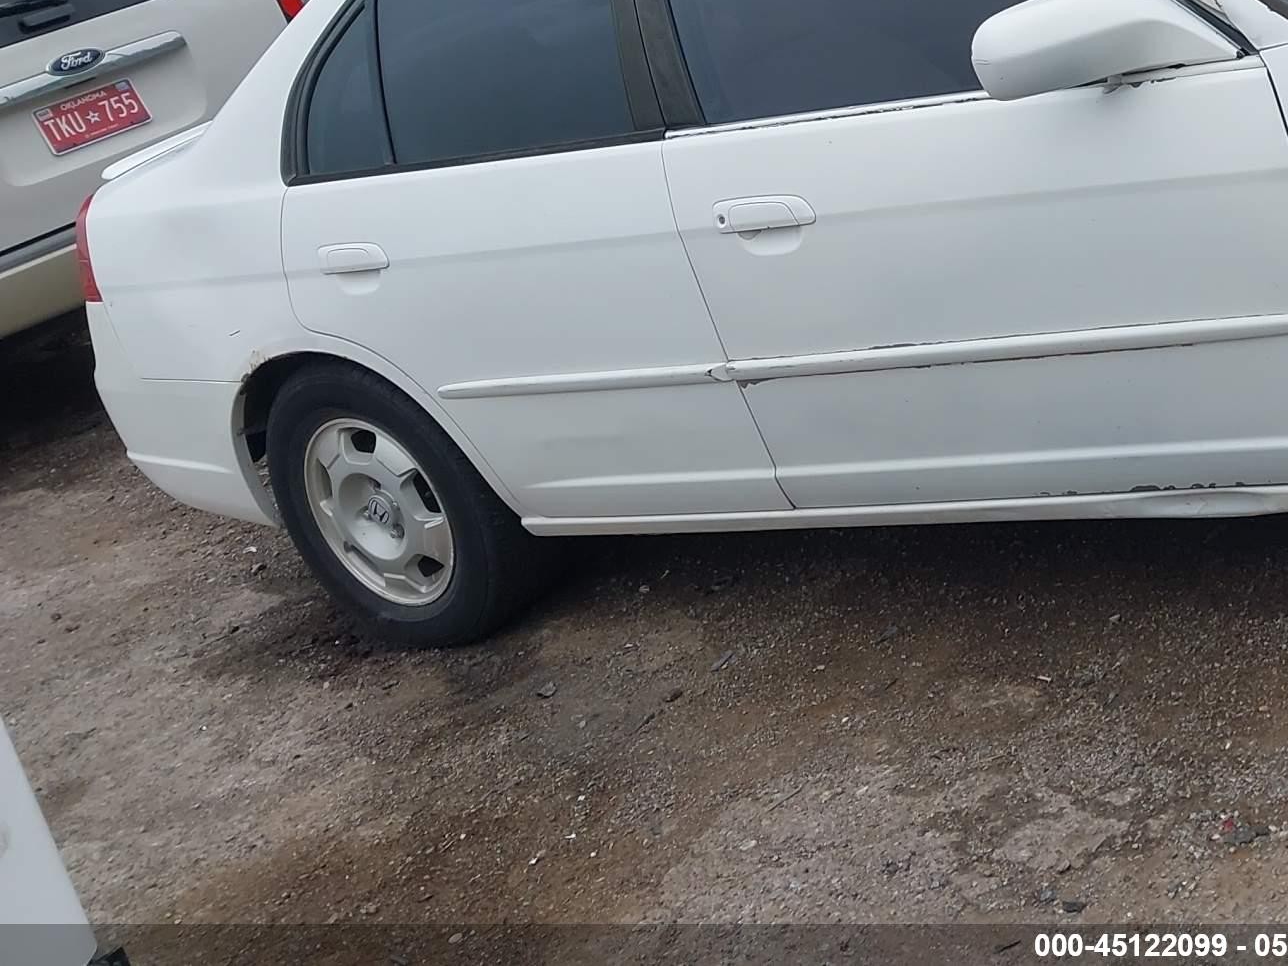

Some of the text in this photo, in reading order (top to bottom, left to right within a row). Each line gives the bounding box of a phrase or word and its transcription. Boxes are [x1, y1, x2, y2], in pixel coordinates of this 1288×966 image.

[60, 51, 92, 71] Ford
[60, 90, 107, 111] OKLAHOMA
[43, 111, 87, 142] TKU
[98, 92, 139, 122] 755
